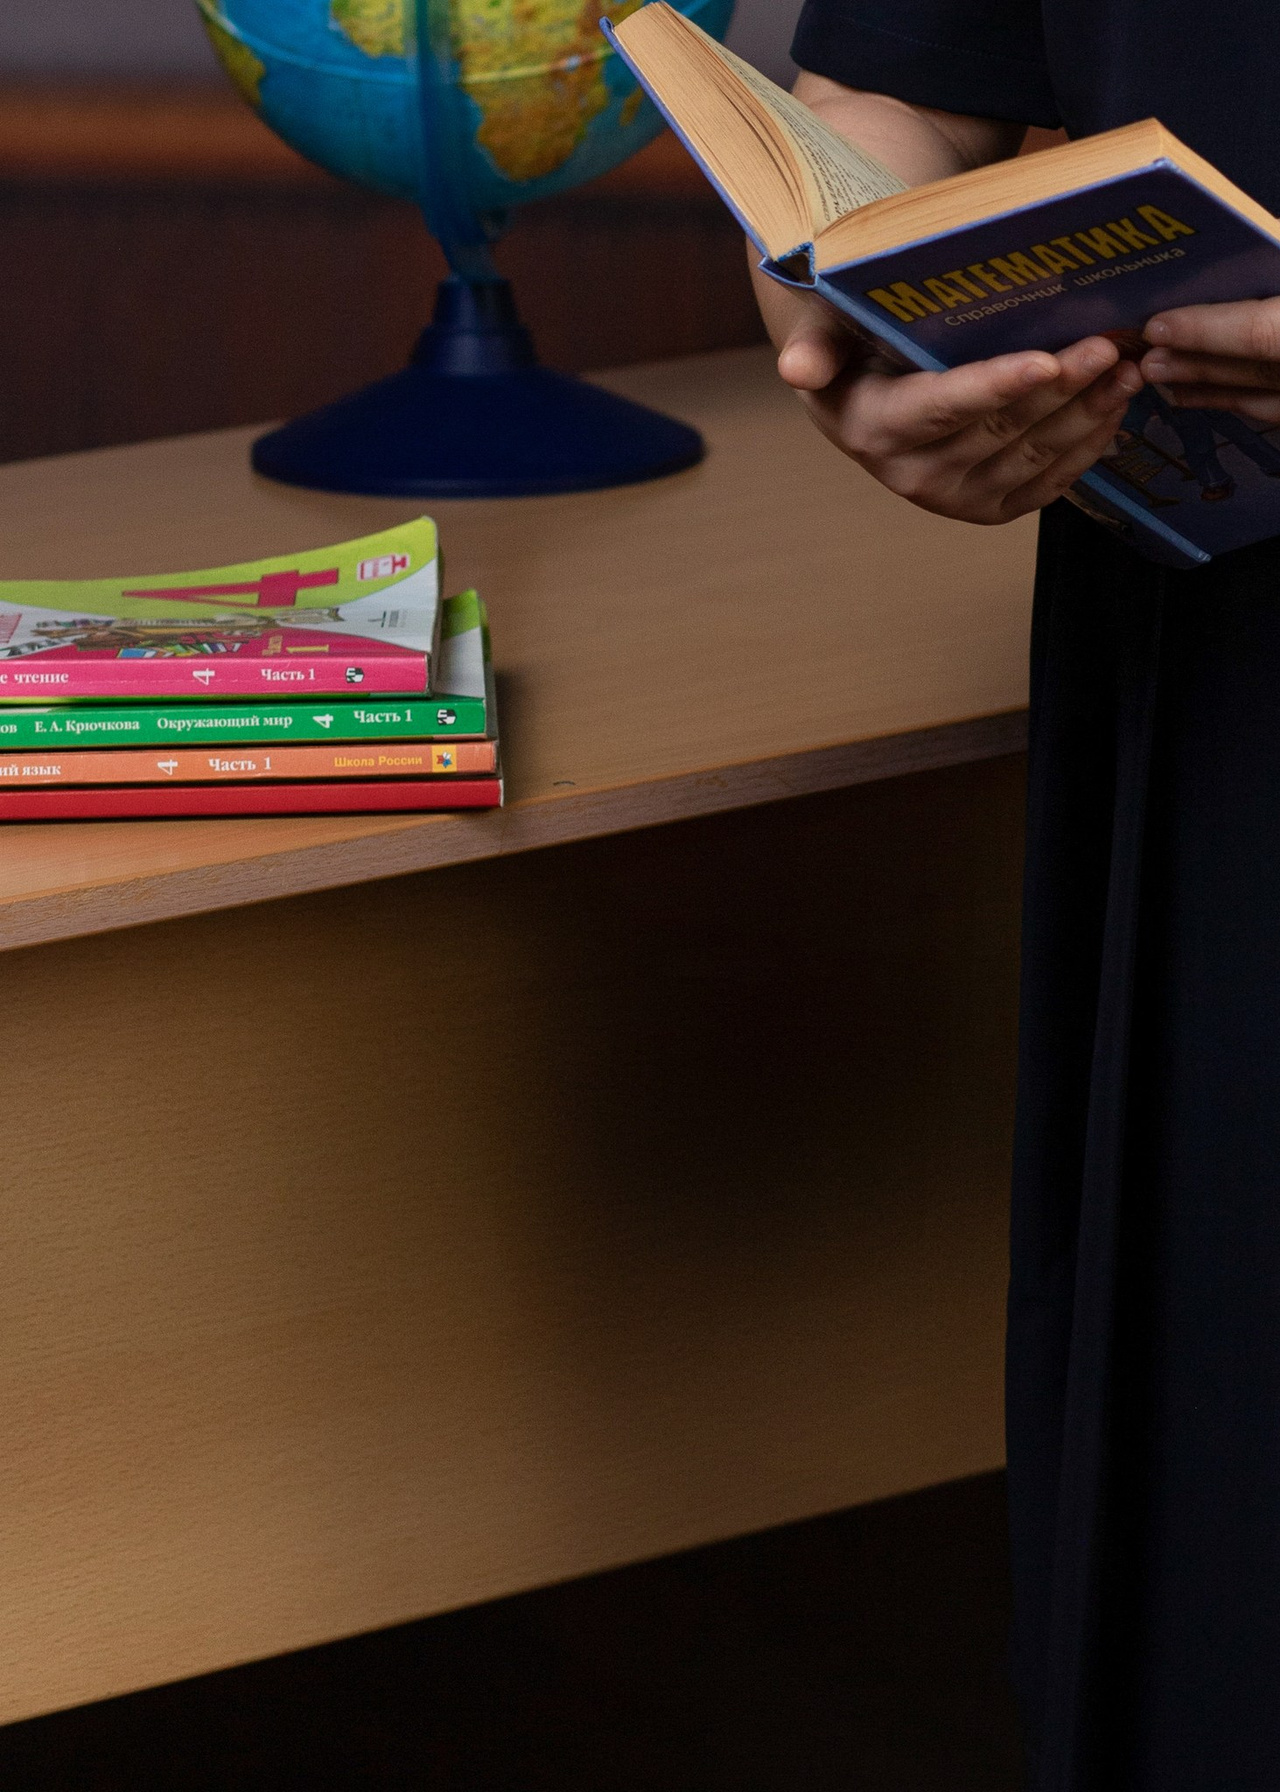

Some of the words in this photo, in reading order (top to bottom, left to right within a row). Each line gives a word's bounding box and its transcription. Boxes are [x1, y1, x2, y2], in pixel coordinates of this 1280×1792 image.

[1074, 246, 1187, 287] школьника
[122, 568, 340, 608] 4
[14, 673, 69, 684] чтение
[192, 668, 215, 685] 4
[261, 668, 305, 681] Часть
[309, 667, 316, 681] 1
[65, 720, 140, 734] Крючкова
[157, 715, 260, 731] Окружающий
[262, 714, 293, 729] мир
[312, 714, 335, 729] 4
[353, 709, 401, 724] Часть
[405, 708, 413, 722] 1
[22, 764, 62, 776] язык
[157, 758, 179, 775] 4
[208, 757, 257, 772] Часть
[264, 756, 272, 770] 1
[334, 756, 375, 768] Школа
[378, 755, 423, 767] России
